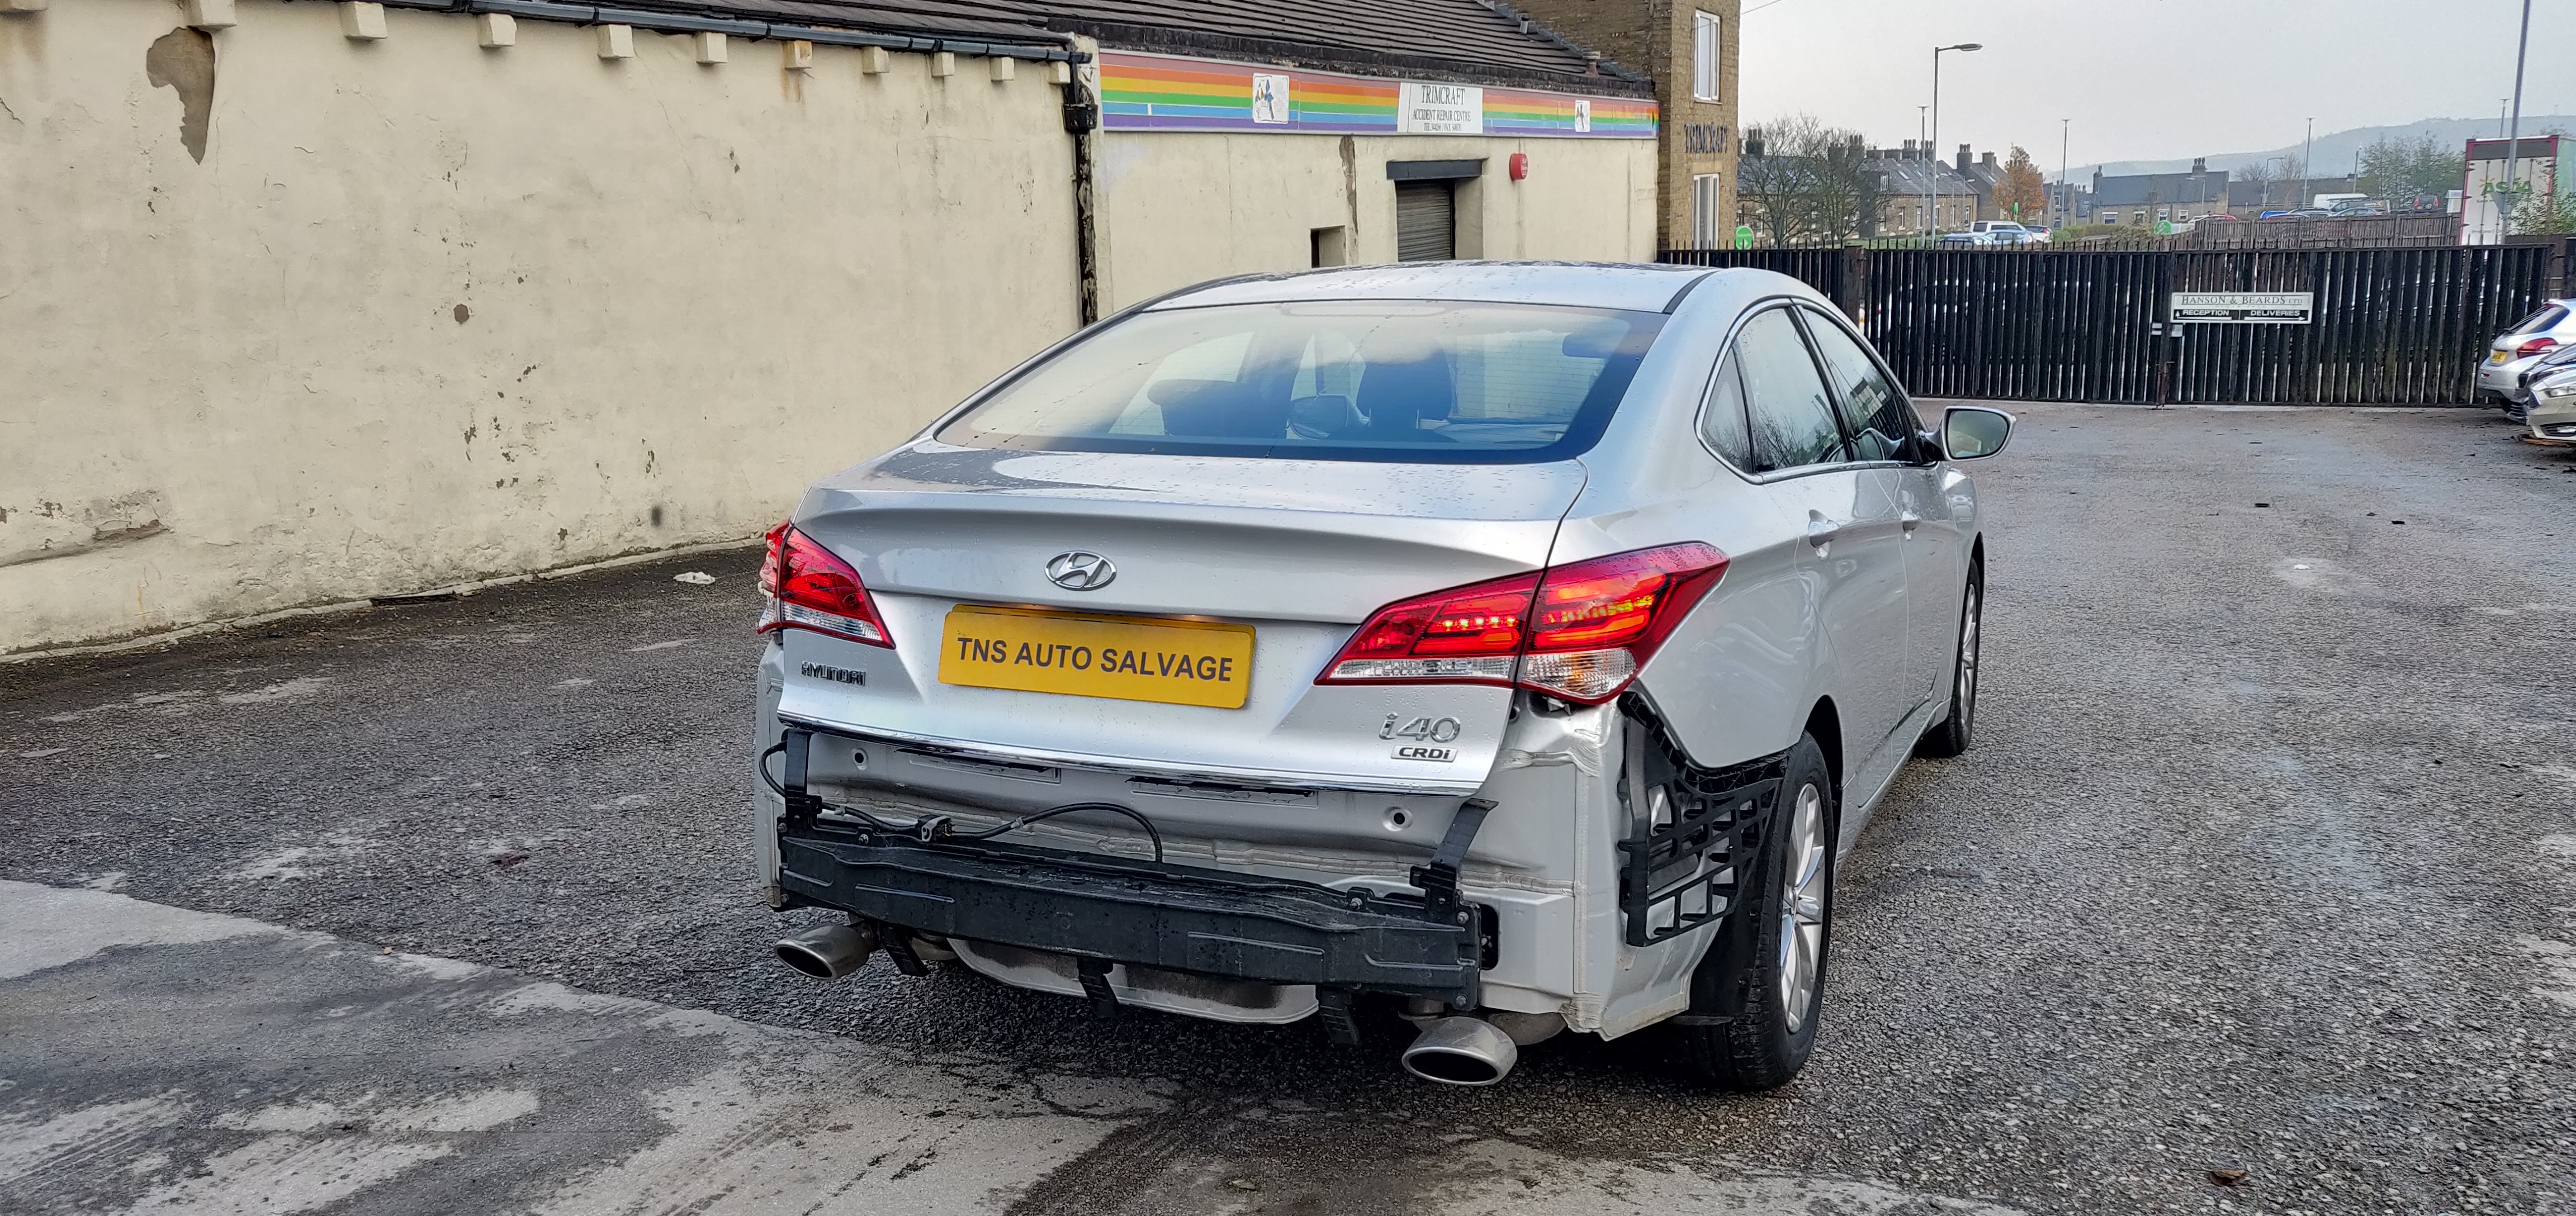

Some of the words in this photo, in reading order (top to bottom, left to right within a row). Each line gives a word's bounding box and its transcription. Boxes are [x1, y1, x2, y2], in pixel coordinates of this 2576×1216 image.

[1422, 85, 1465, 105] TRIMCRAFT
[1412, 108, 1436, 121] ACCIDENT
[1437, 110, 1453, 121] REPAIR
[1453, 111, 1471, 121] CENTRE
[1684, 124, 1730, 153] TRIMCRAFT
[2181, 296, 2225, 304] HANSON
[2230, 296, 2238, 305] &
[2242, 296, 2285, 305] BEARDS
[956, 637, 1007, 663] TNS
[1014, 642, 1092, 670] AUTO
[1100, 648, 1233, 682] SALVAGE
[801, 660, 866, 686] HYUNDAI
[1379, 711, 1461, 743] i40
